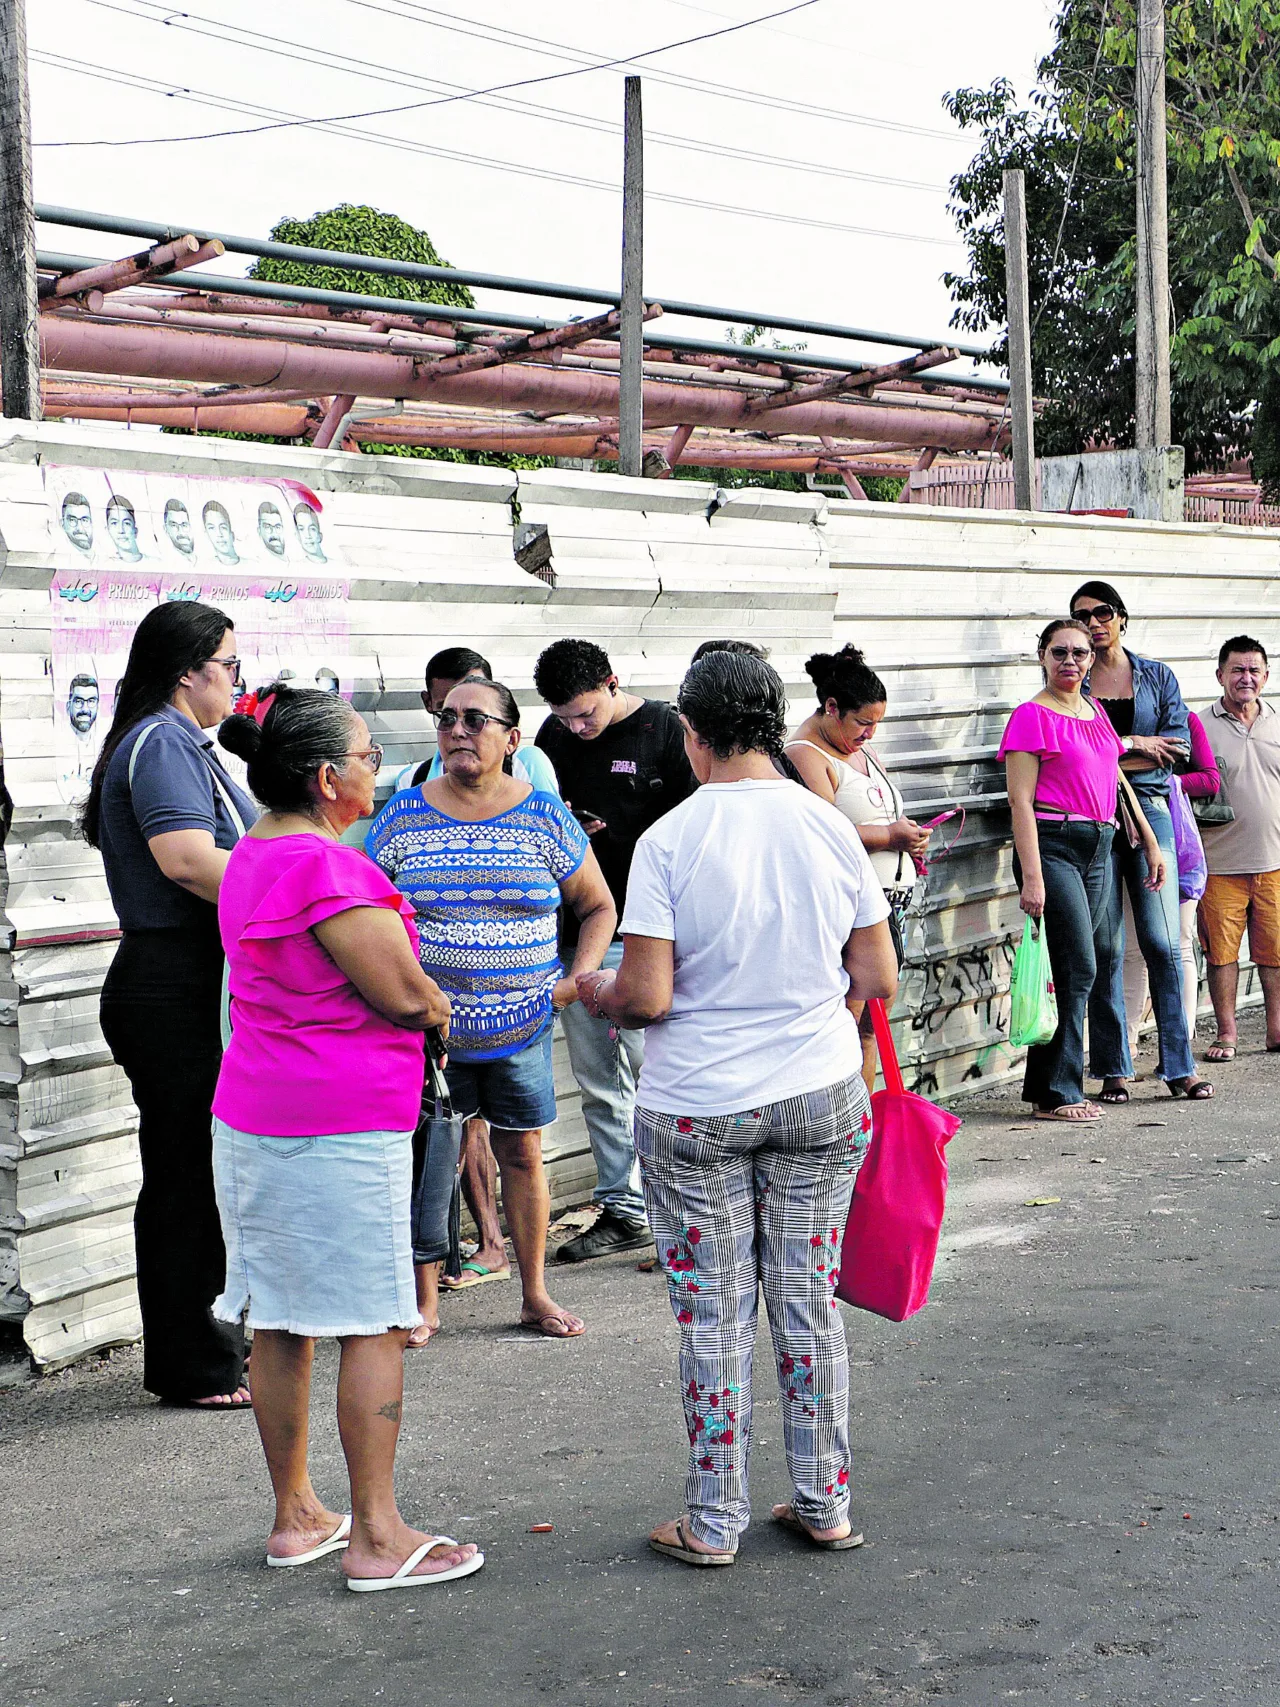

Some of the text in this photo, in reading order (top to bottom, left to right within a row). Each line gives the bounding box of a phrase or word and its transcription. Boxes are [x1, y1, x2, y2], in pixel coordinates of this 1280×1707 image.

[59, 579, 151, 602] 40 PRIMOS
[210, 585, 249, 601] PRIMOS
[264, 580, 344, 602] 40 PRIMOS
